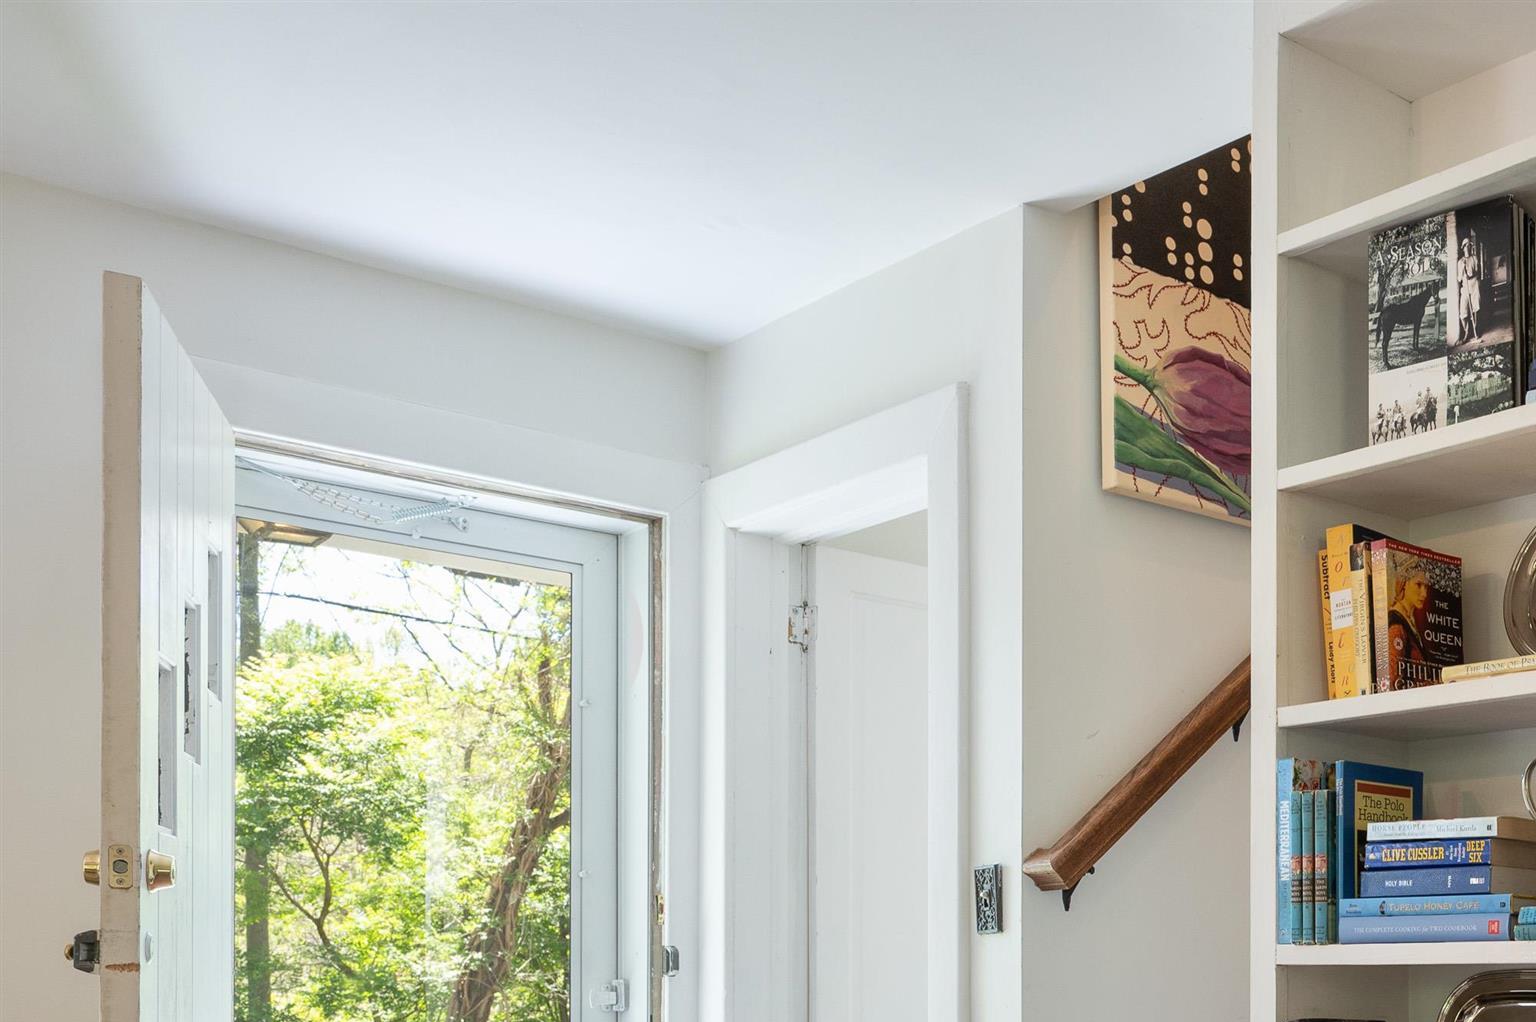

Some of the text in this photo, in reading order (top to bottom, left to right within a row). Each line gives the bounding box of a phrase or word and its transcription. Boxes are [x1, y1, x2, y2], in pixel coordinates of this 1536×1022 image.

[1435, 600, 1448, 610] THE
[1426, 612, 1460, 629] WHITE
[1425, 630, 1462, 647] QUEEN
[1363, 795, 1405, 812] The Polo
[1358, 808, 1409, 822] Handbook
[1280, 800, 1291, 882] MEDITERRANEAN
[1466, 840, 1486, 852] DEEP
[1382, 848, 1406, 862] CLIVE
[1408, 846, 1444, 860] CUSSLER
[1468, 852, 1482, 863] SIX
